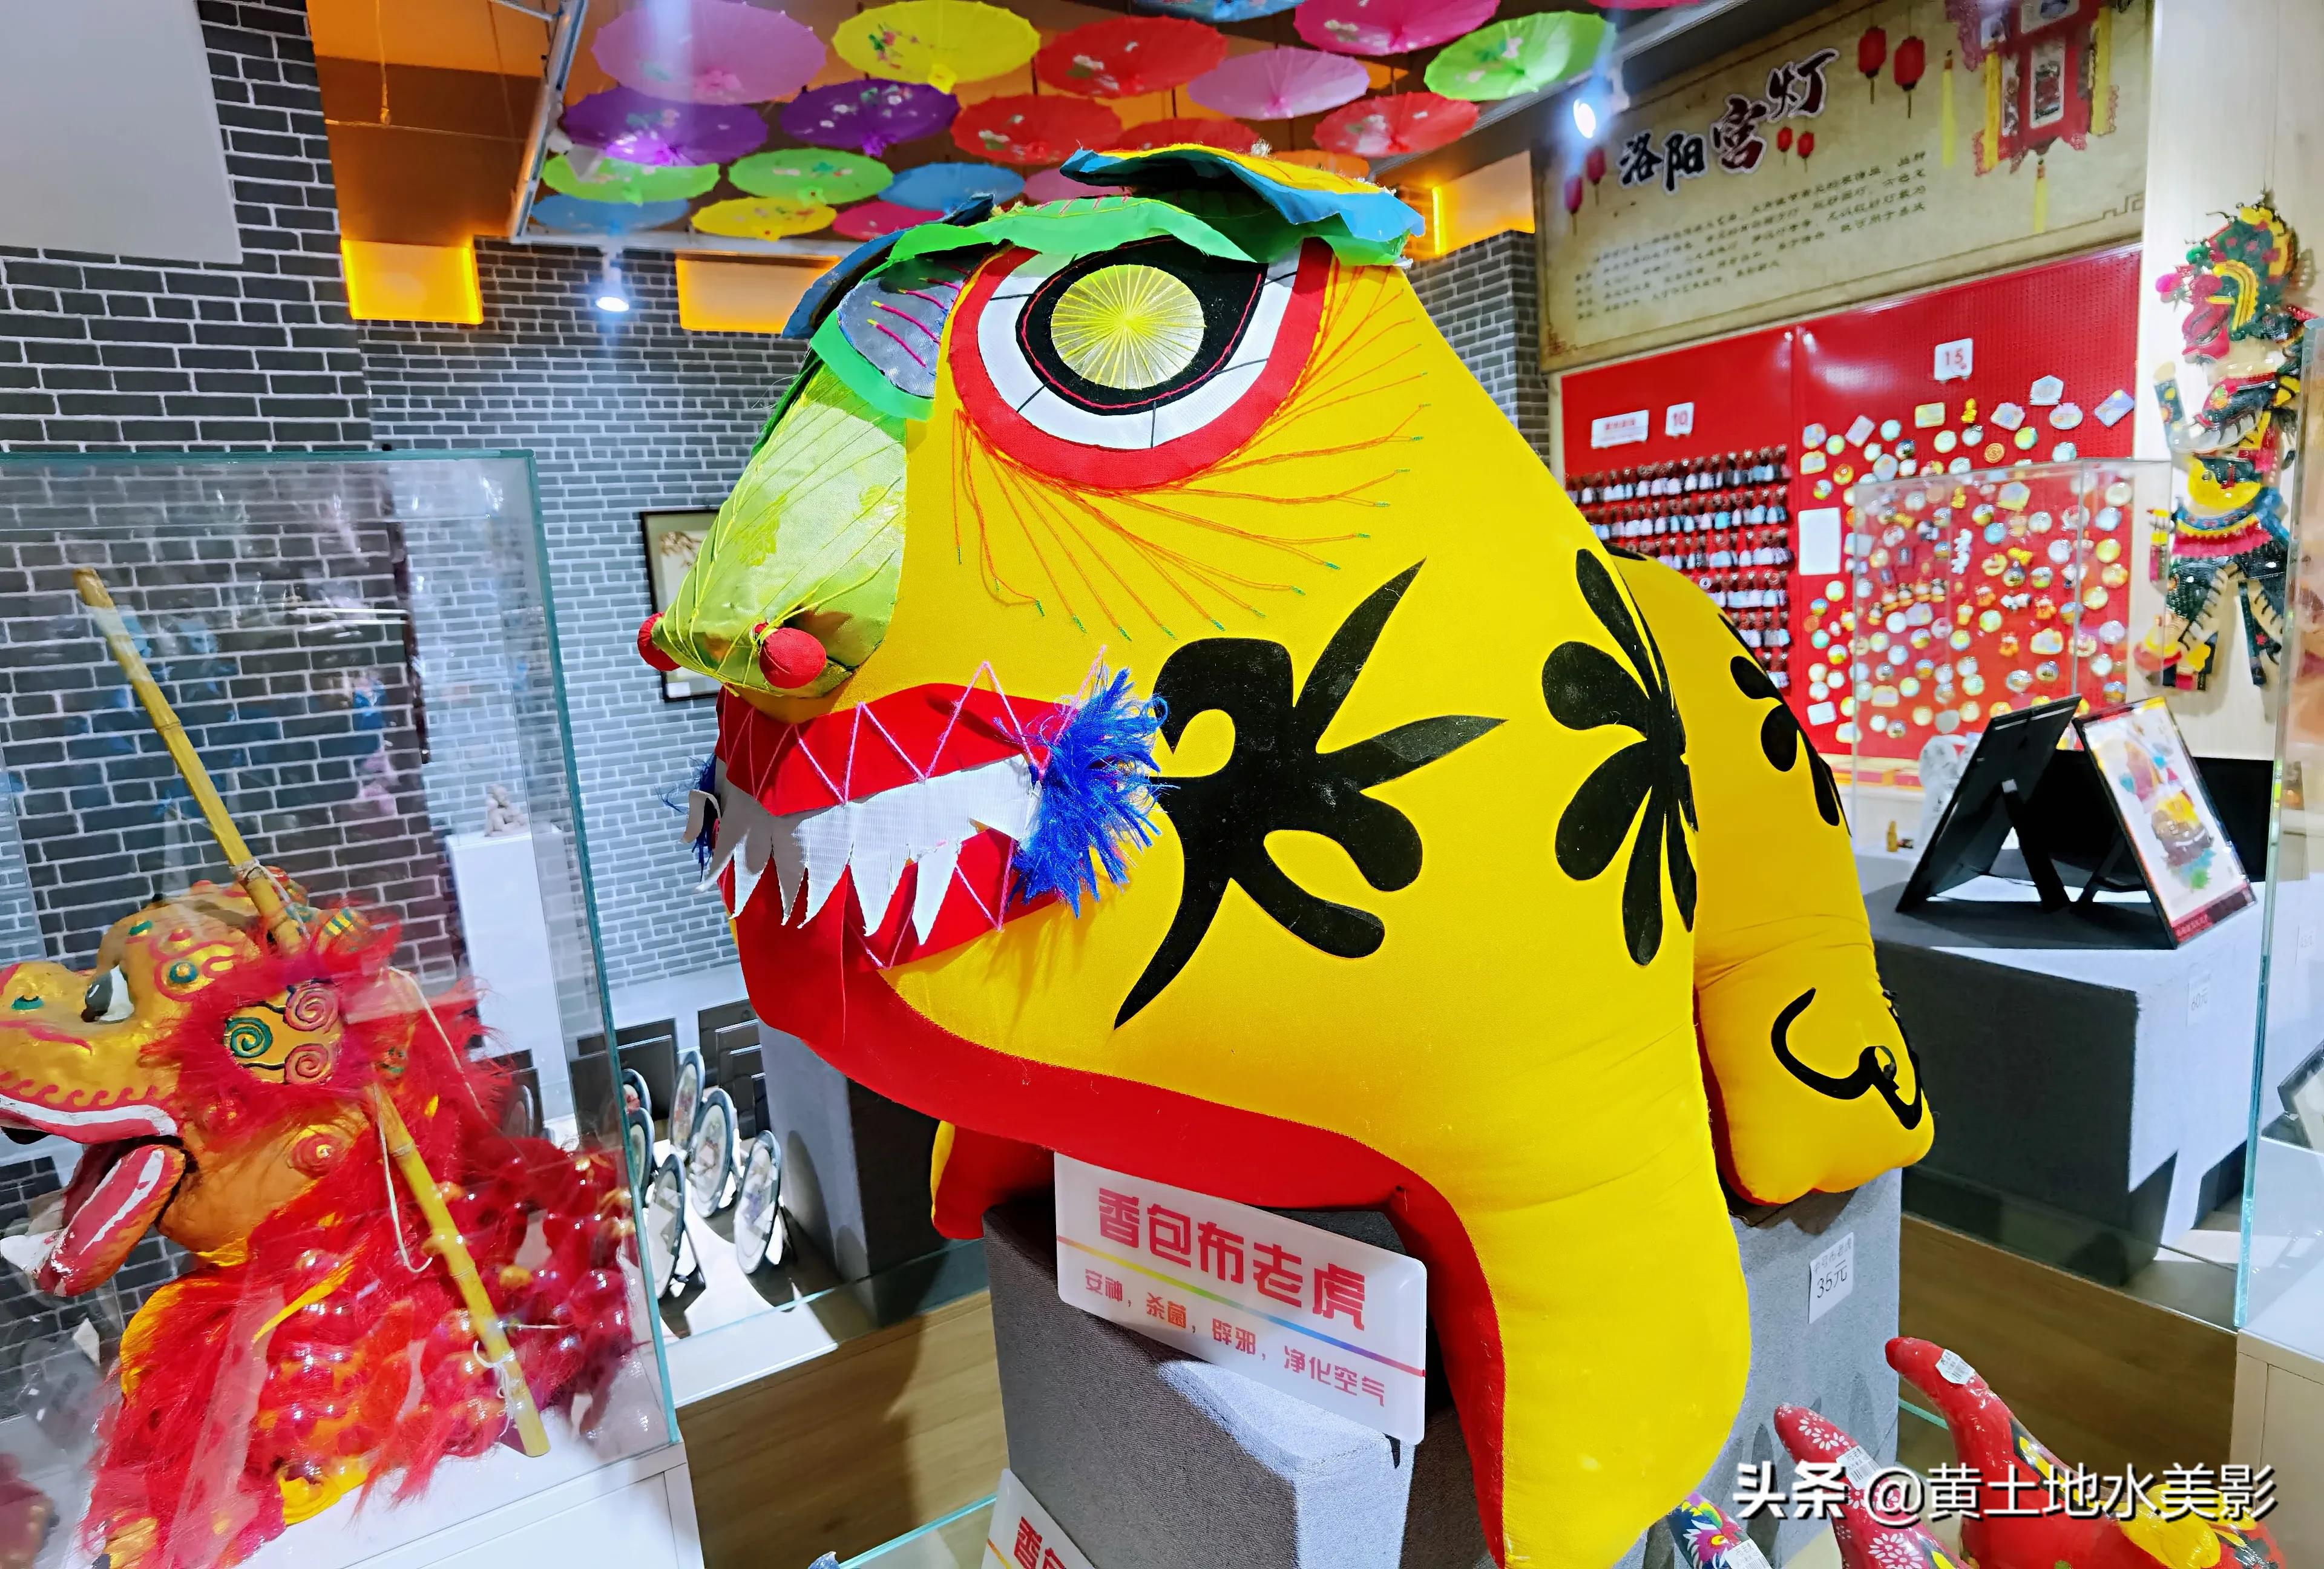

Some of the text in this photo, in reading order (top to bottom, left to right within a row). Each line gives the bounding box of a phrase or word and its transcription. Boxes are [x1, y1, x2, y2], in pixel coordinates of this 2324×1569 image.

[1620, 48, 1837, 192] 洛阳宫灯
[1098, 1188, 1365, 1331] 香包布老虎
[1817, 1259, 1847, 1298] 35元
